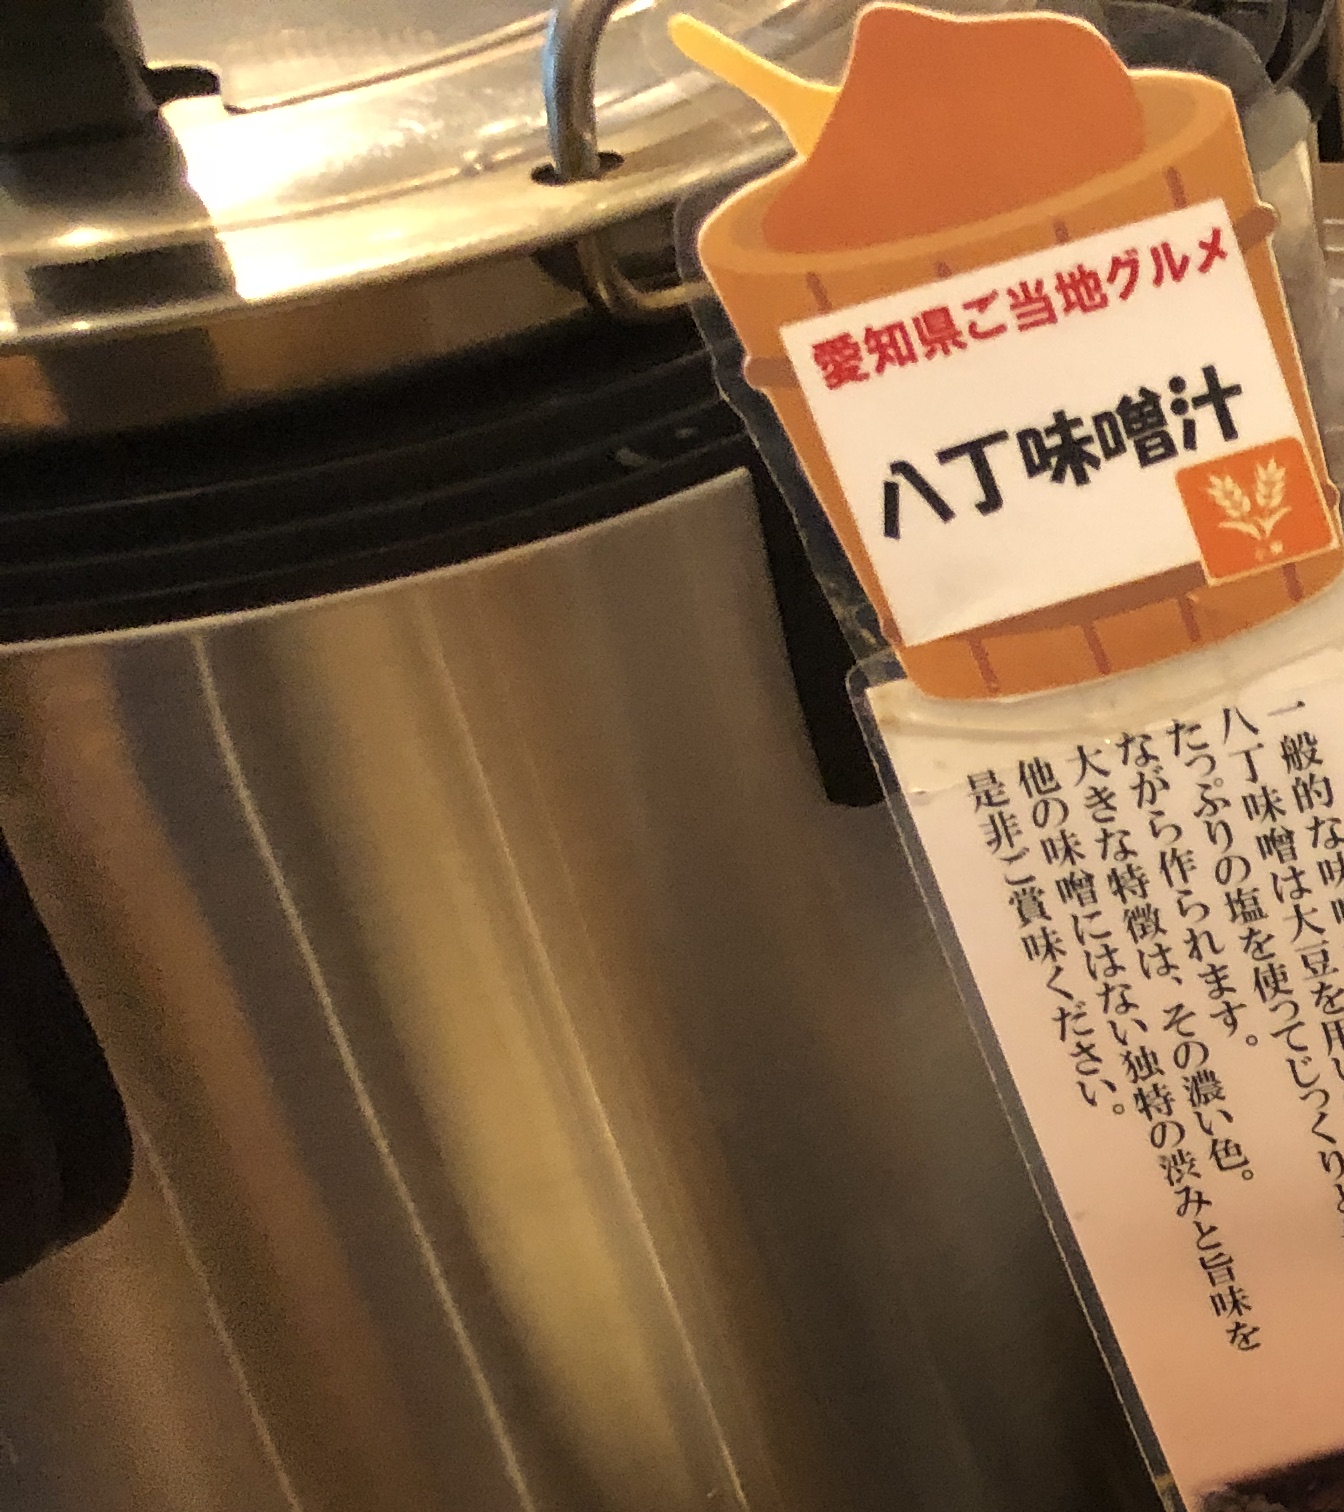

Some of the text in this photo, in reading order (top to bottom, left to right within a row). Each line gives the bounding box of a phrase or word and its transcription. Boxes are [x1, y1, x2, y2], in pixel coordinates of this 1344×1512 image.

[811, 226, 1228, 391] 愛知県ご当地グルメ
[882, 364, 1243, 540] 八丁味噌汁
[966, 769, 1126, 1117] 是非ご賞味ください。
[1017, 756, 1260, 1352] 他の味噌にはない独特の渋みと旨味を
[1066, 744, 1255, 1181] 大きな特徴は、その濃い色。
[1115, 731, 1258, 1047] ながら作られます。
